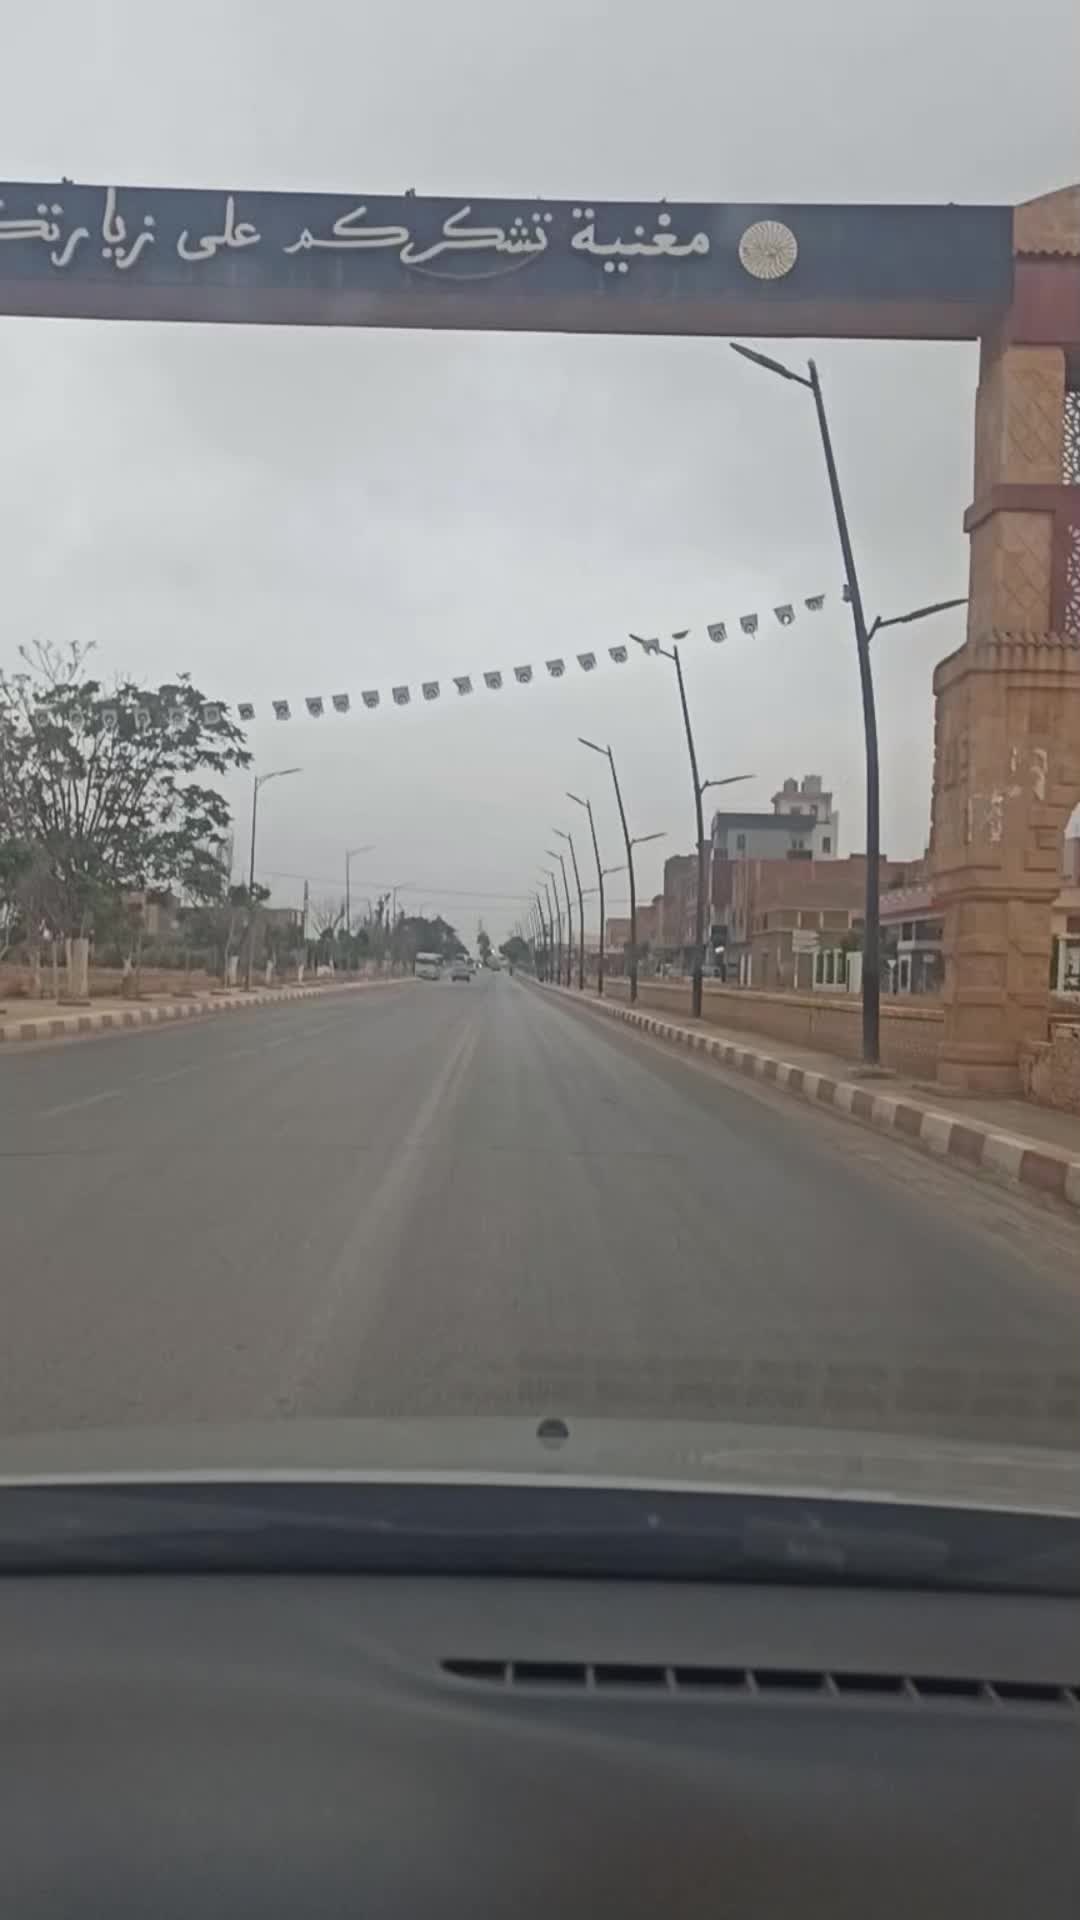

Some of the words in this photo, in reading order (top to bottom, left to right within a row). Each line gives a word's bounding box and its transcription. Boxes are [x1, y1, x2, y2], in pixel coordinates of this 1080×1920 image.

[177, 197, 261, 261] على
[284, 206, 553, 265] تشكركم
[571, 208, 710, 273] مغنية
